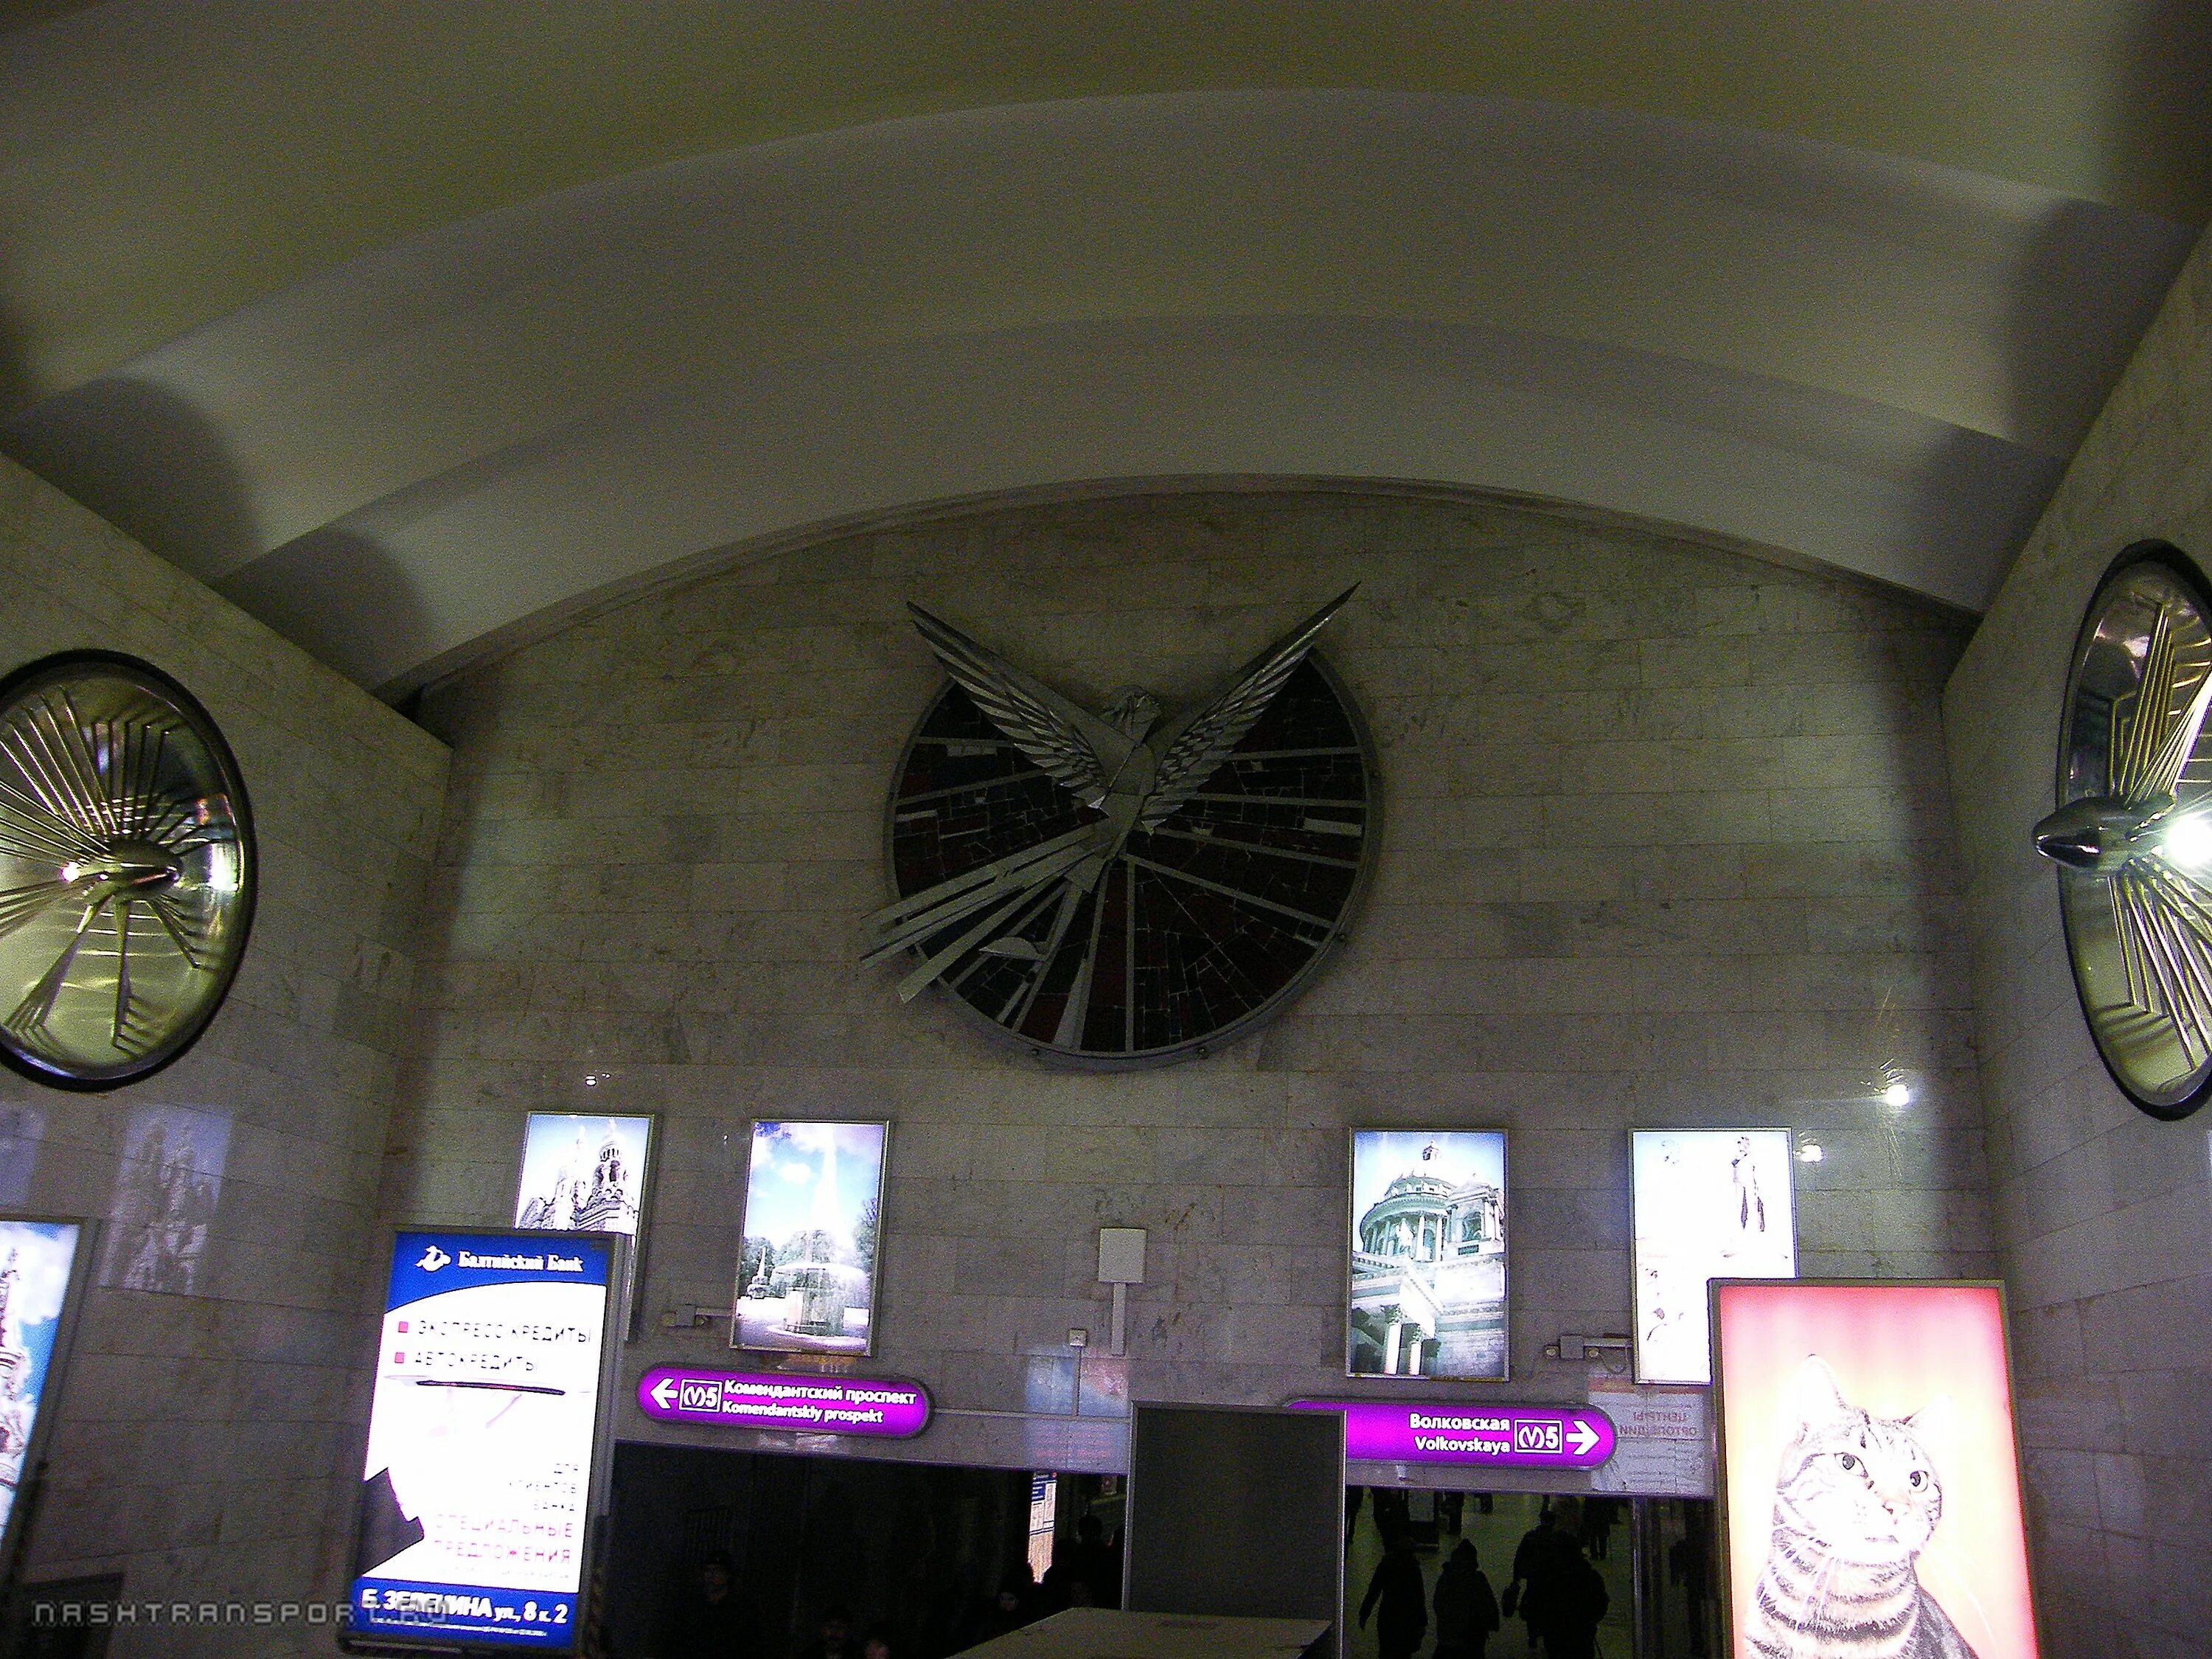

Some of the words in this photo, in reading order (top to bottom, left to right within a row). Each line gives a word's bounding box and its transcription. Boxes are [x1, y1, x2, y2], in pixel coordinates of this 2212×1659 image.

[546, 1253, 584, 1273] Банк
[724, 1379, 844, 1401] Комендантский
[845, 1389, 917, 1405] проспект
[824, 1408, 884, 1425] prospekt
[1409, 1412, 1512, 1432] Волковская
[1413, 1435, 1512, 1456] Volkovskaya
[523, 1600, 538, 1621] 8
[553, 1603, 569, 1624] 2
